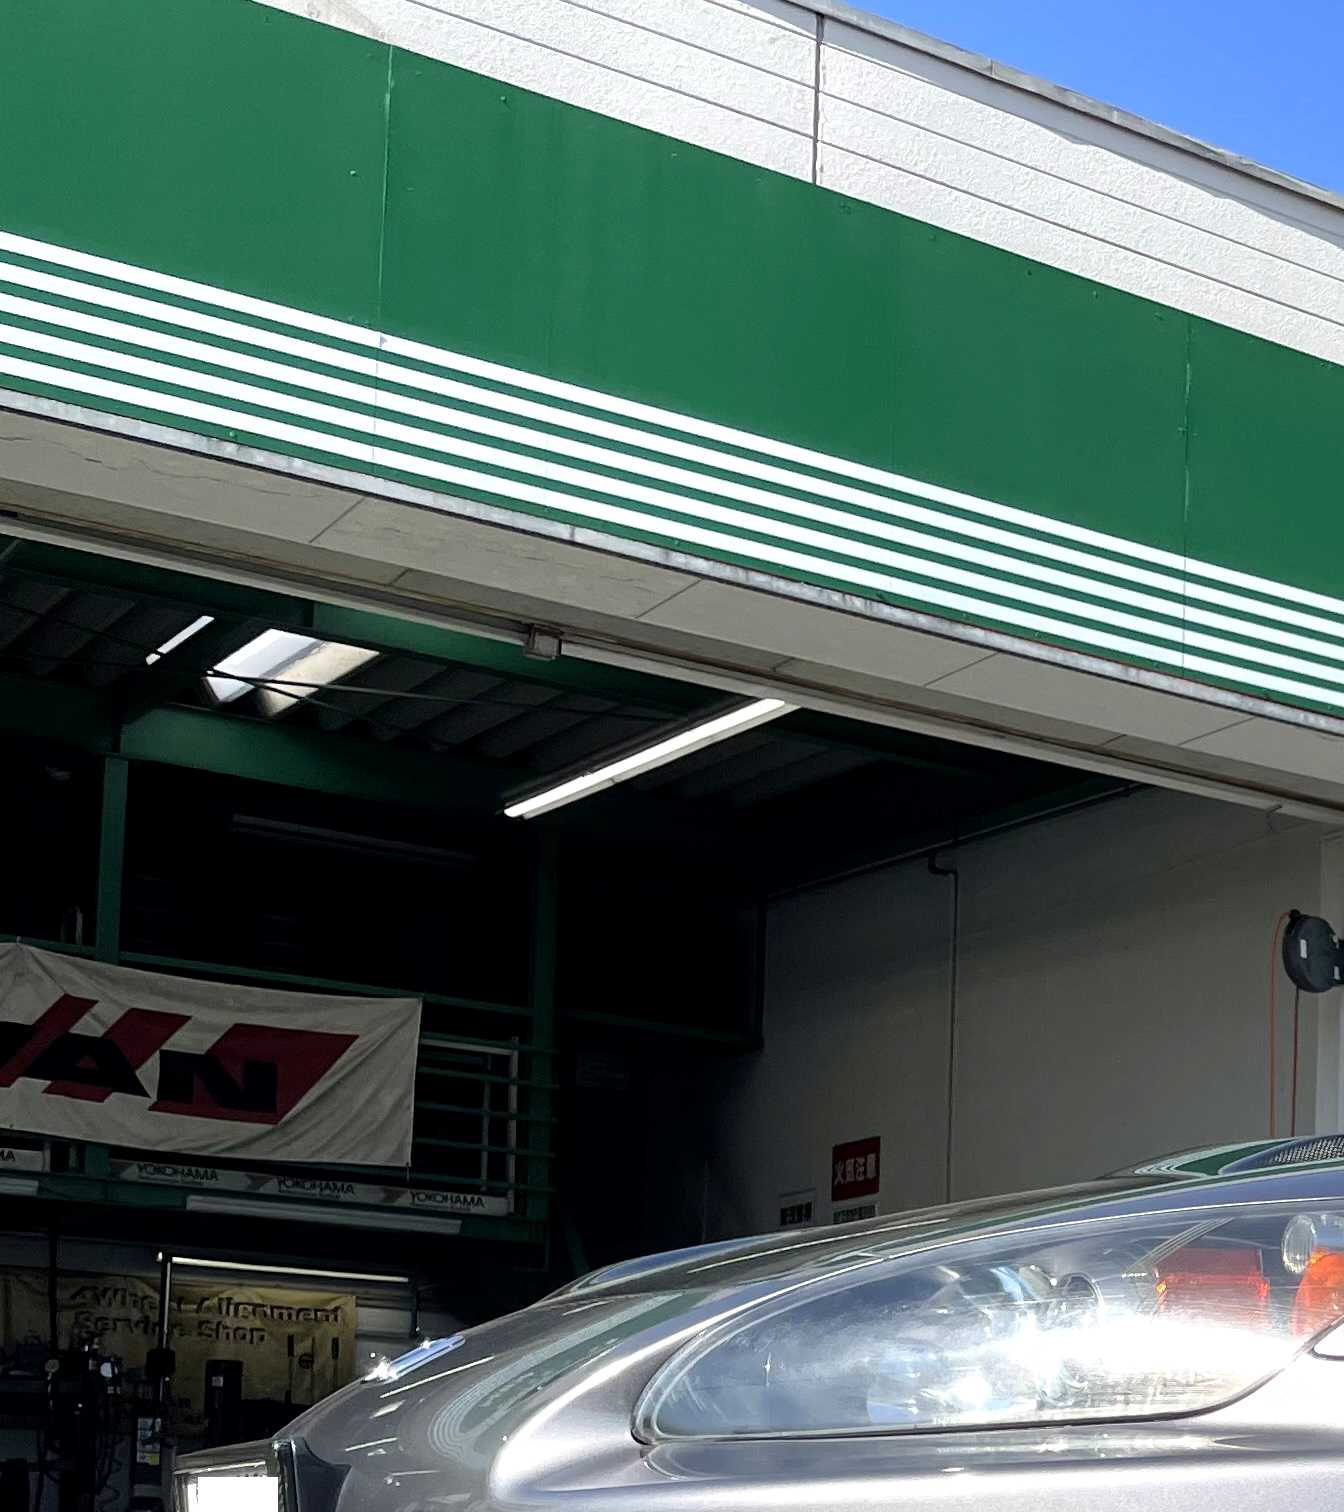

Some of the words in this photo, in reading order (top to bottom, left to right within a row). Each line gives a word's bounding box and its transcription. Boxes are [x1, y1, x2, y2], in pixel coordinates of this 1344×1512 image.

[137, 1163, 219, 1182] YOKOHAMA
[409, 1190, 486, 1209] YOKOHAMA
[198, 1319, 269, 1346] Shop
